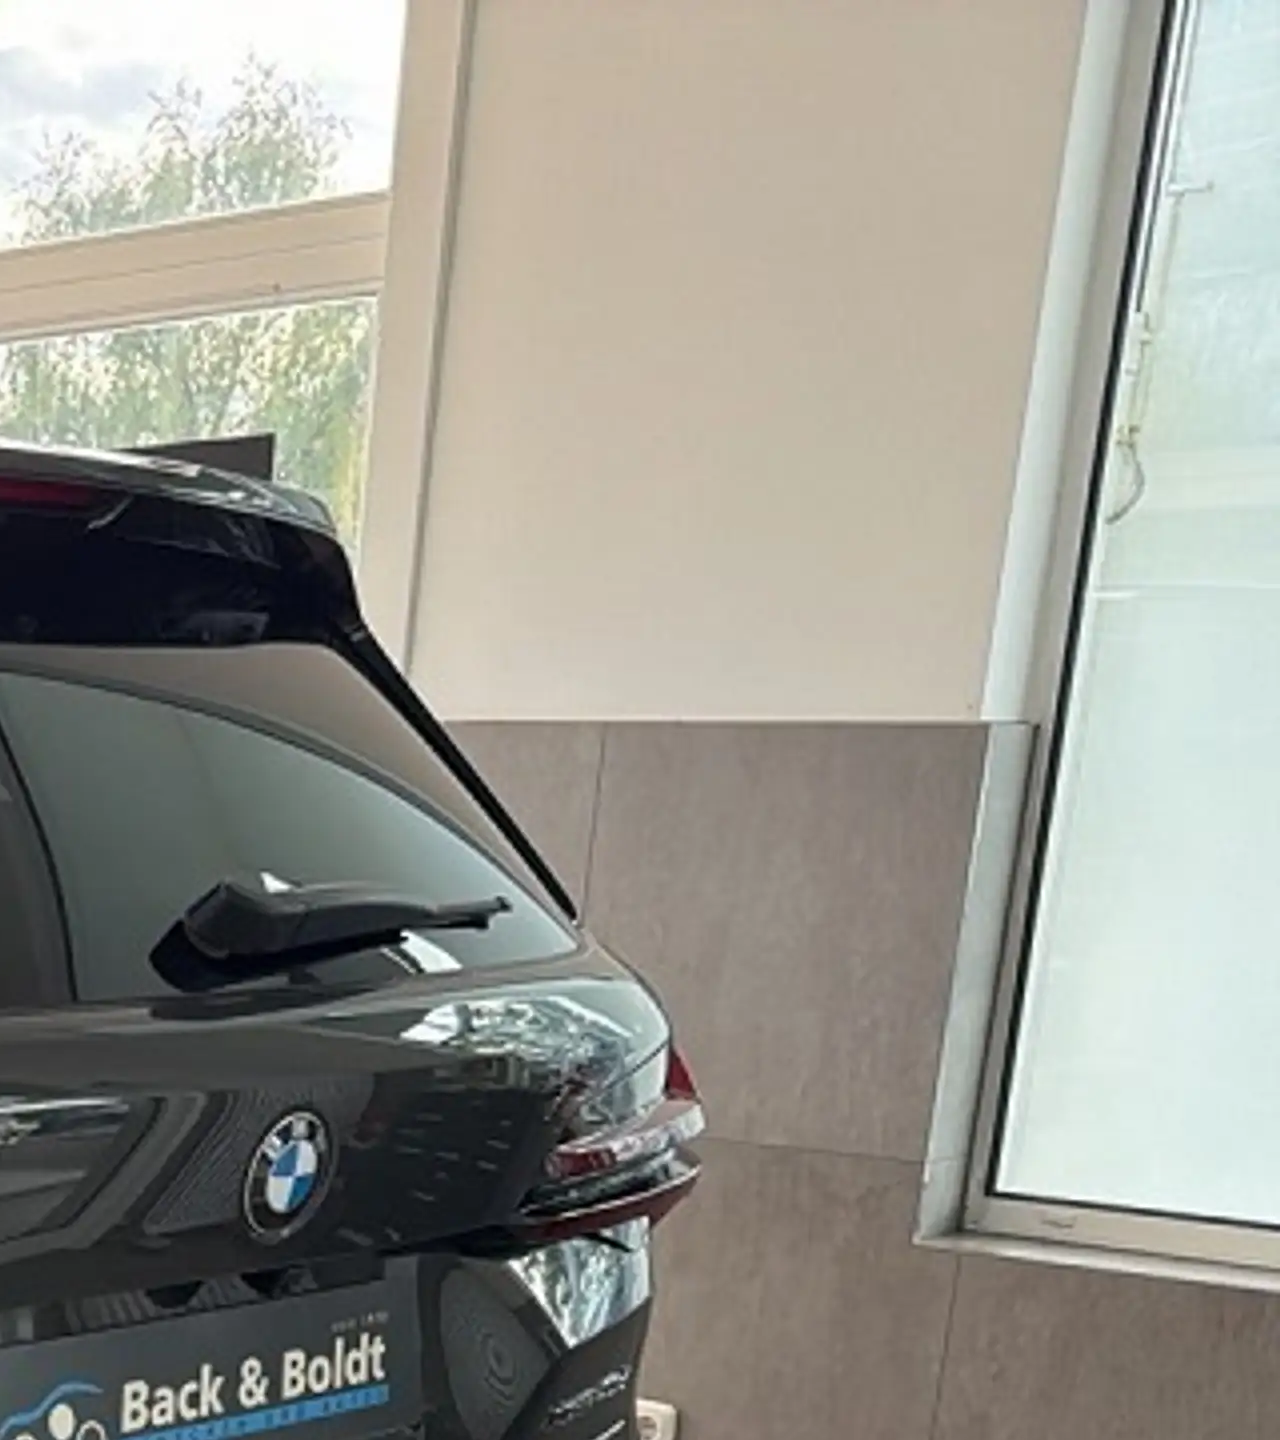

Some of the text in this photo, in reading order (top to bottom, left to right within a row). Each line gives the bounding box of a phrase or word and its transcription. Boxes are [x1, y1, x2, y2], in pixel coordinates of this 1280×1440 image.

[120, 1363, 226, 1434] Back
[237, 1355, 270, 1409] &
[281, 1331, 386, 1400] Boldt
